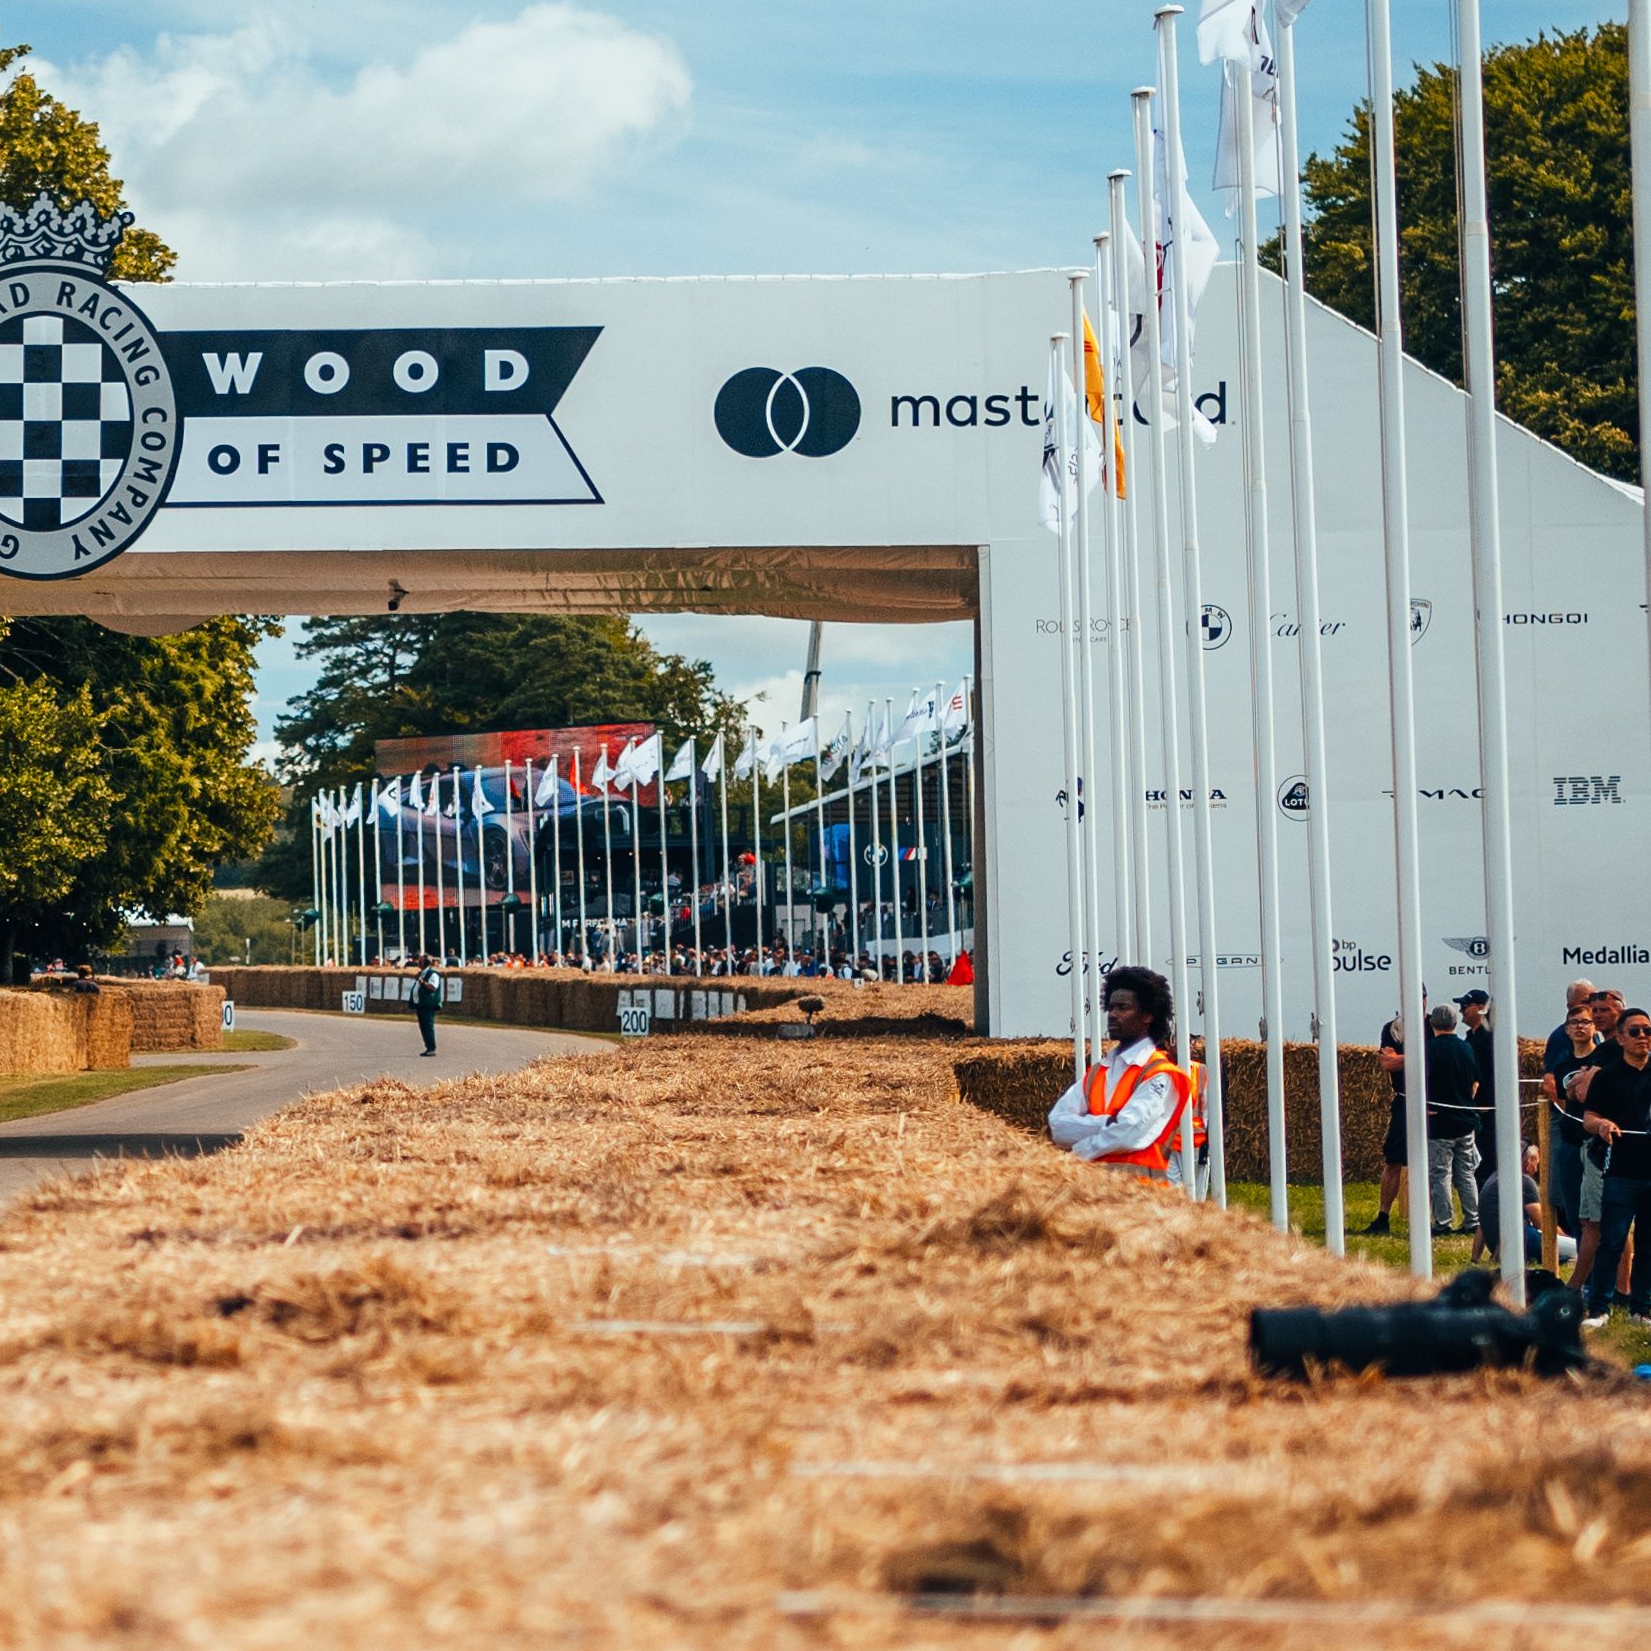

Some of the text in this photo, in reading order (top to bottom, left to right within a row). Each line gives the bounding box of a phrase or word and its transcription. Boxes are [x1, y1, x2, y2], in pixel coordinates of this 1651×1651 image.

[56, 280, 160, 387] RACING
[202, 350, 529, 394] WOOD
[208, 442, 519, 475] OF SPEED
[72, 406, 168, 560] COMPANY
[1553, 775, 1622, 805] IBM
[1342, 939, 1356, 950] bp
[1563, 946, 1650, 965] Medallia
[344, 993, 363, 1013] 150
[622, 1010, 647, 1033] 200
